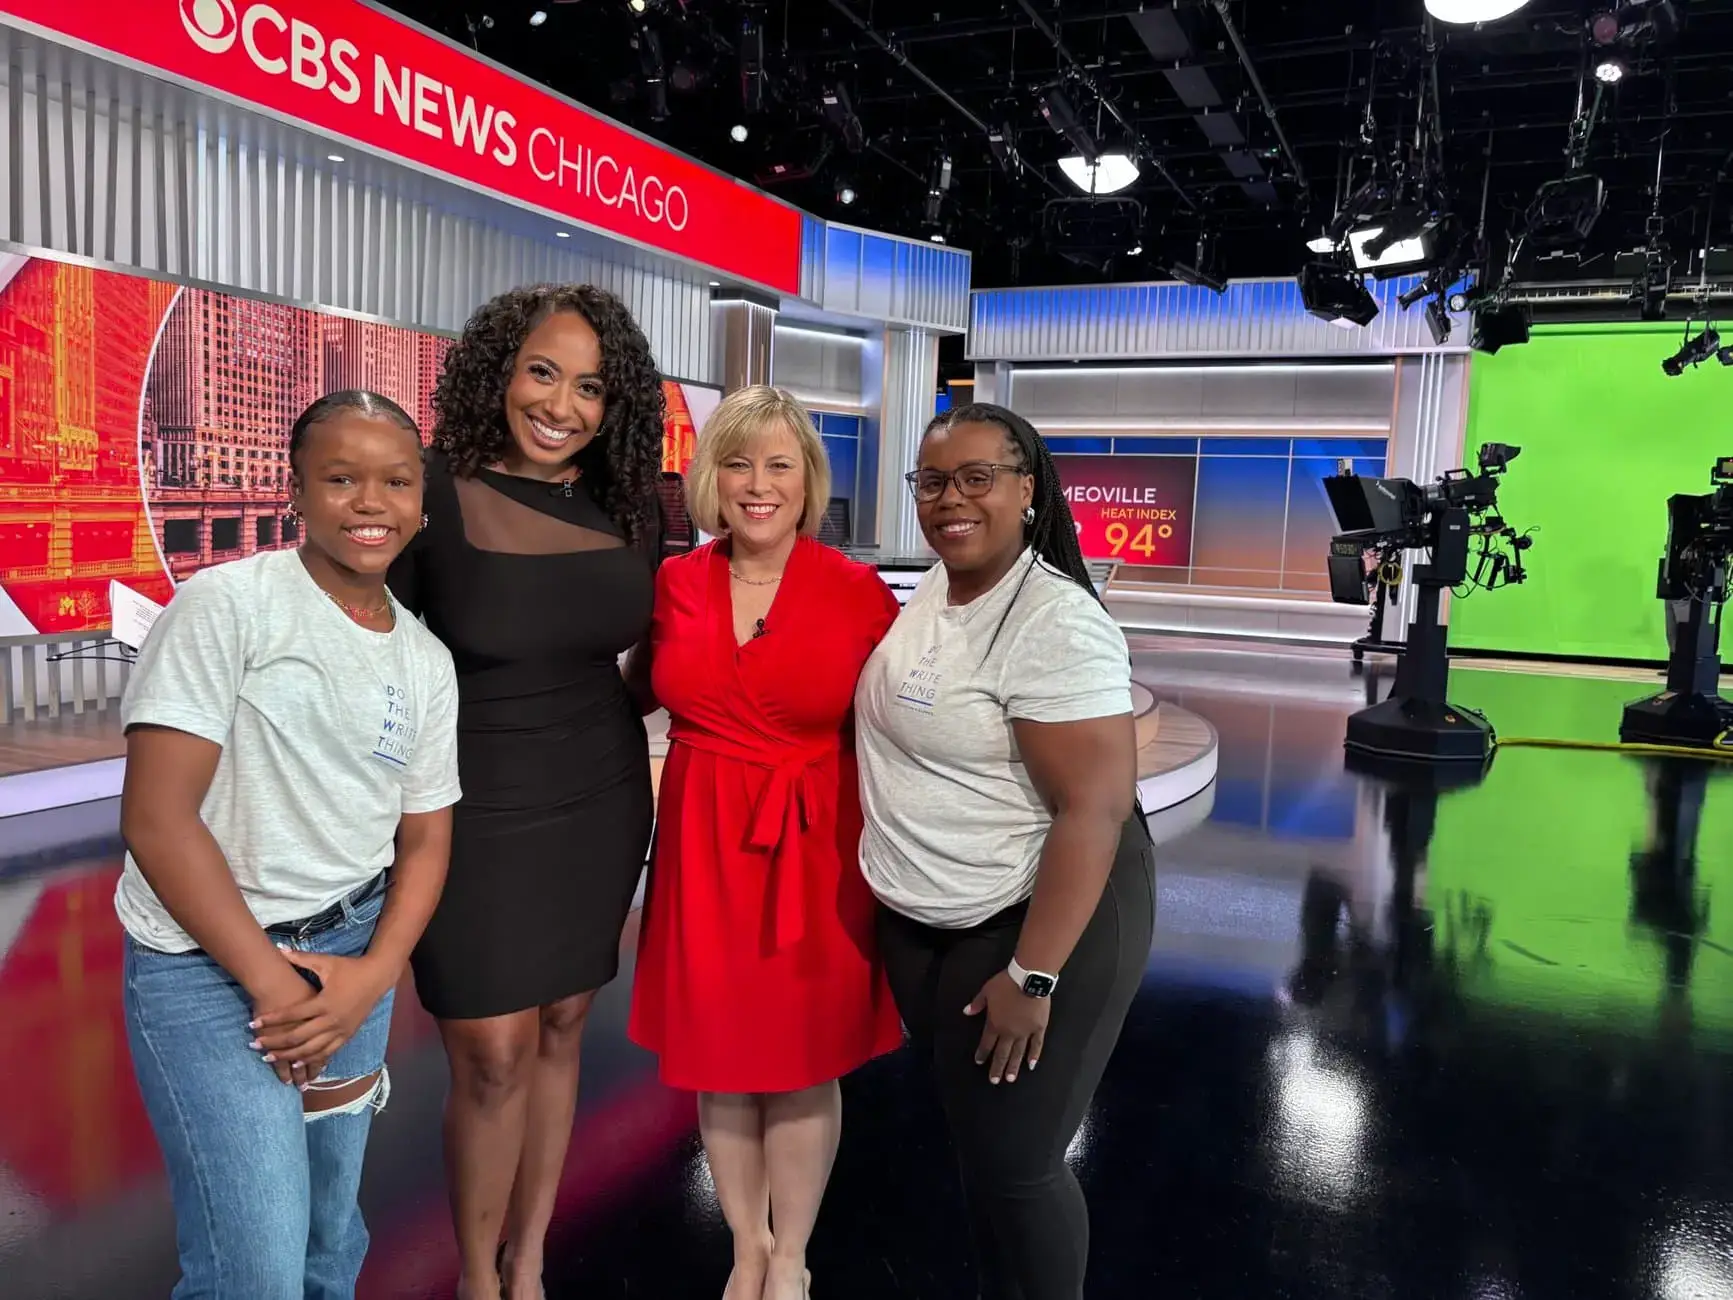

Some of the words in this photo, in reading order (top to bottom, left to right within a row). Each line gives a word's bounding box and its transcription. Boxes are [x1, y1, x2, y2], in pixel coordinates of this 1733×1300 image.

[241, 3, 361, 104] CBS
[373, 54, 517, 166] NEWS
[528, 127, 689, 231] CHICAGO
[1101, 508, 1134, 519] HEAT
[1137, 510, 1176, 520] INDEX
[918, 656, 937, 667] THE
[909, 669, 943, 684] WRITE
[387, 685, 405, 699] DO
[900, 682, 936, 699] THING
[388, 701, 410, 720] THE
[378, 736, 413, 760] THING
